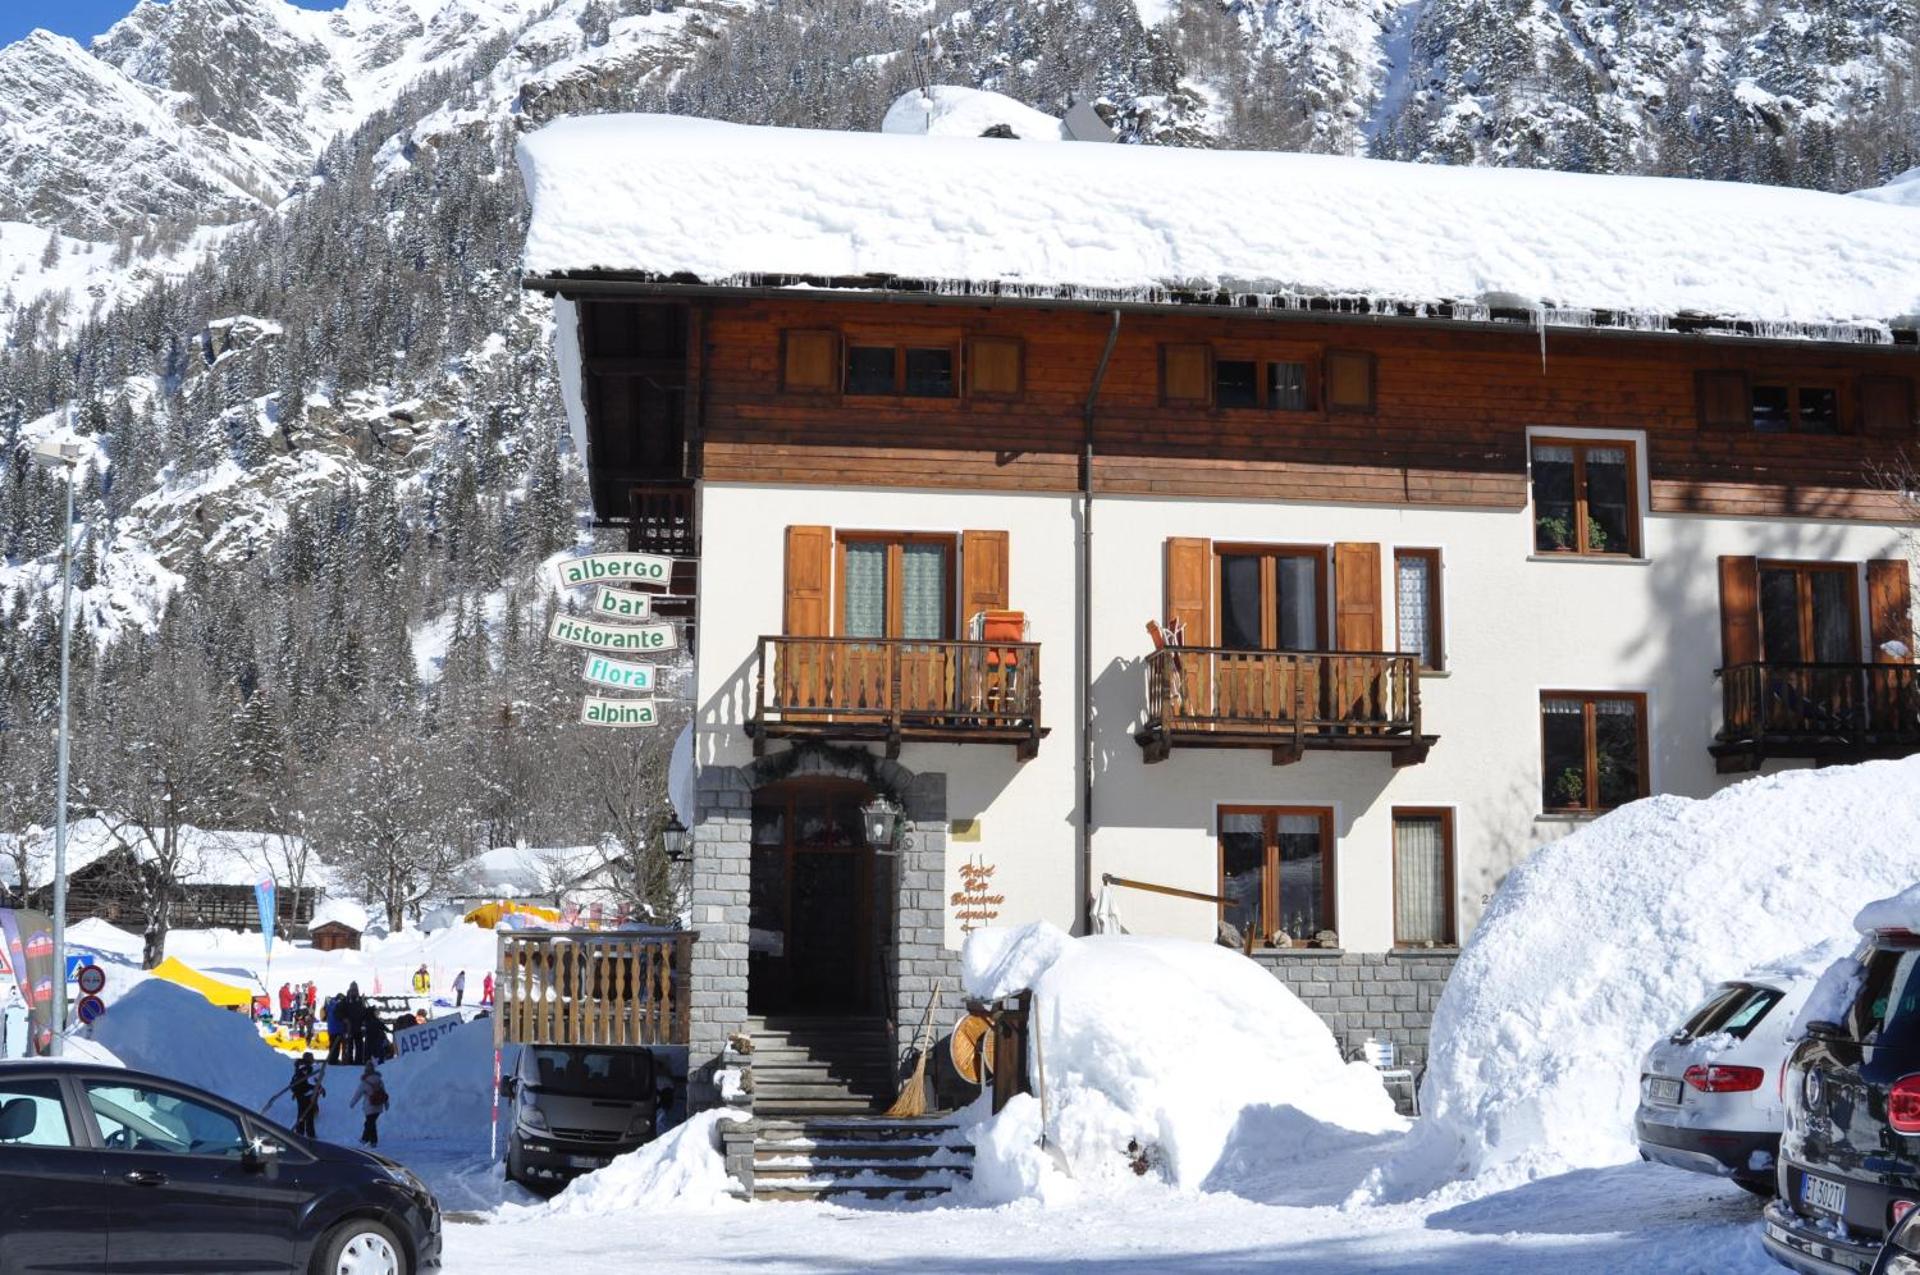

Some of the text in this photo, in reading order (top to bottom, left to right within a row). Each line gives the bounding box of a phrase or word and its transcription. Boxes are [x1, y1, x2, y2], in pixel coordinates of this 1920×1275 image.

[568, 558, 663, 582] albergo
[602, 591, 644, 615] bar
[557, 622, 664, 648] ristorante
[590, 659, 647, 686] flora
[587, 703, 652, 723] alpina
